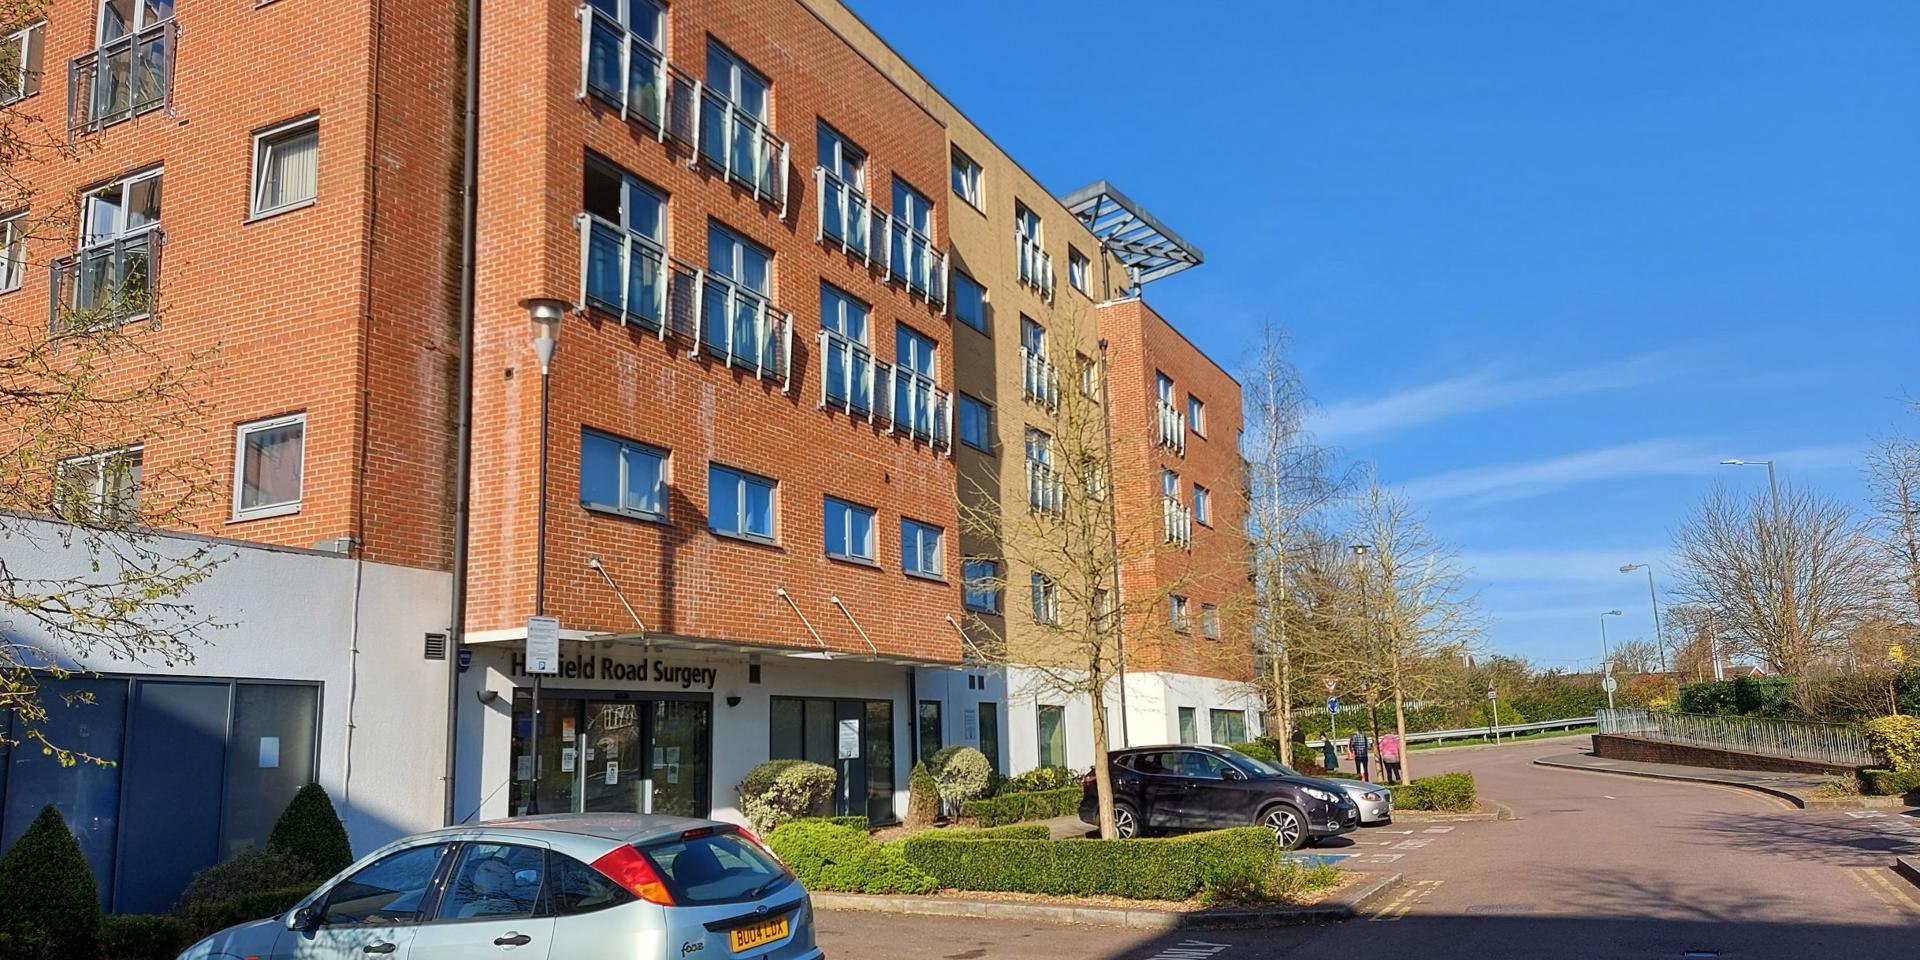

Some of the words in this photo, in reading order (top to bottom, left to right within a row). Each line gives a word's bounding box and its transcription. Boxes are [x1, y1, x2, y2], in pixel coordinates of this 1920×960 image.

[511, 652, 595, 679] Hield
[601, 658, 648, 681] Road
[653, 661, 717, 689] Surgery
[737, 924, 762, 946] BU04
[764, 917, 784, 938] LDX
[1144, 940, 1232, 960] NLY
